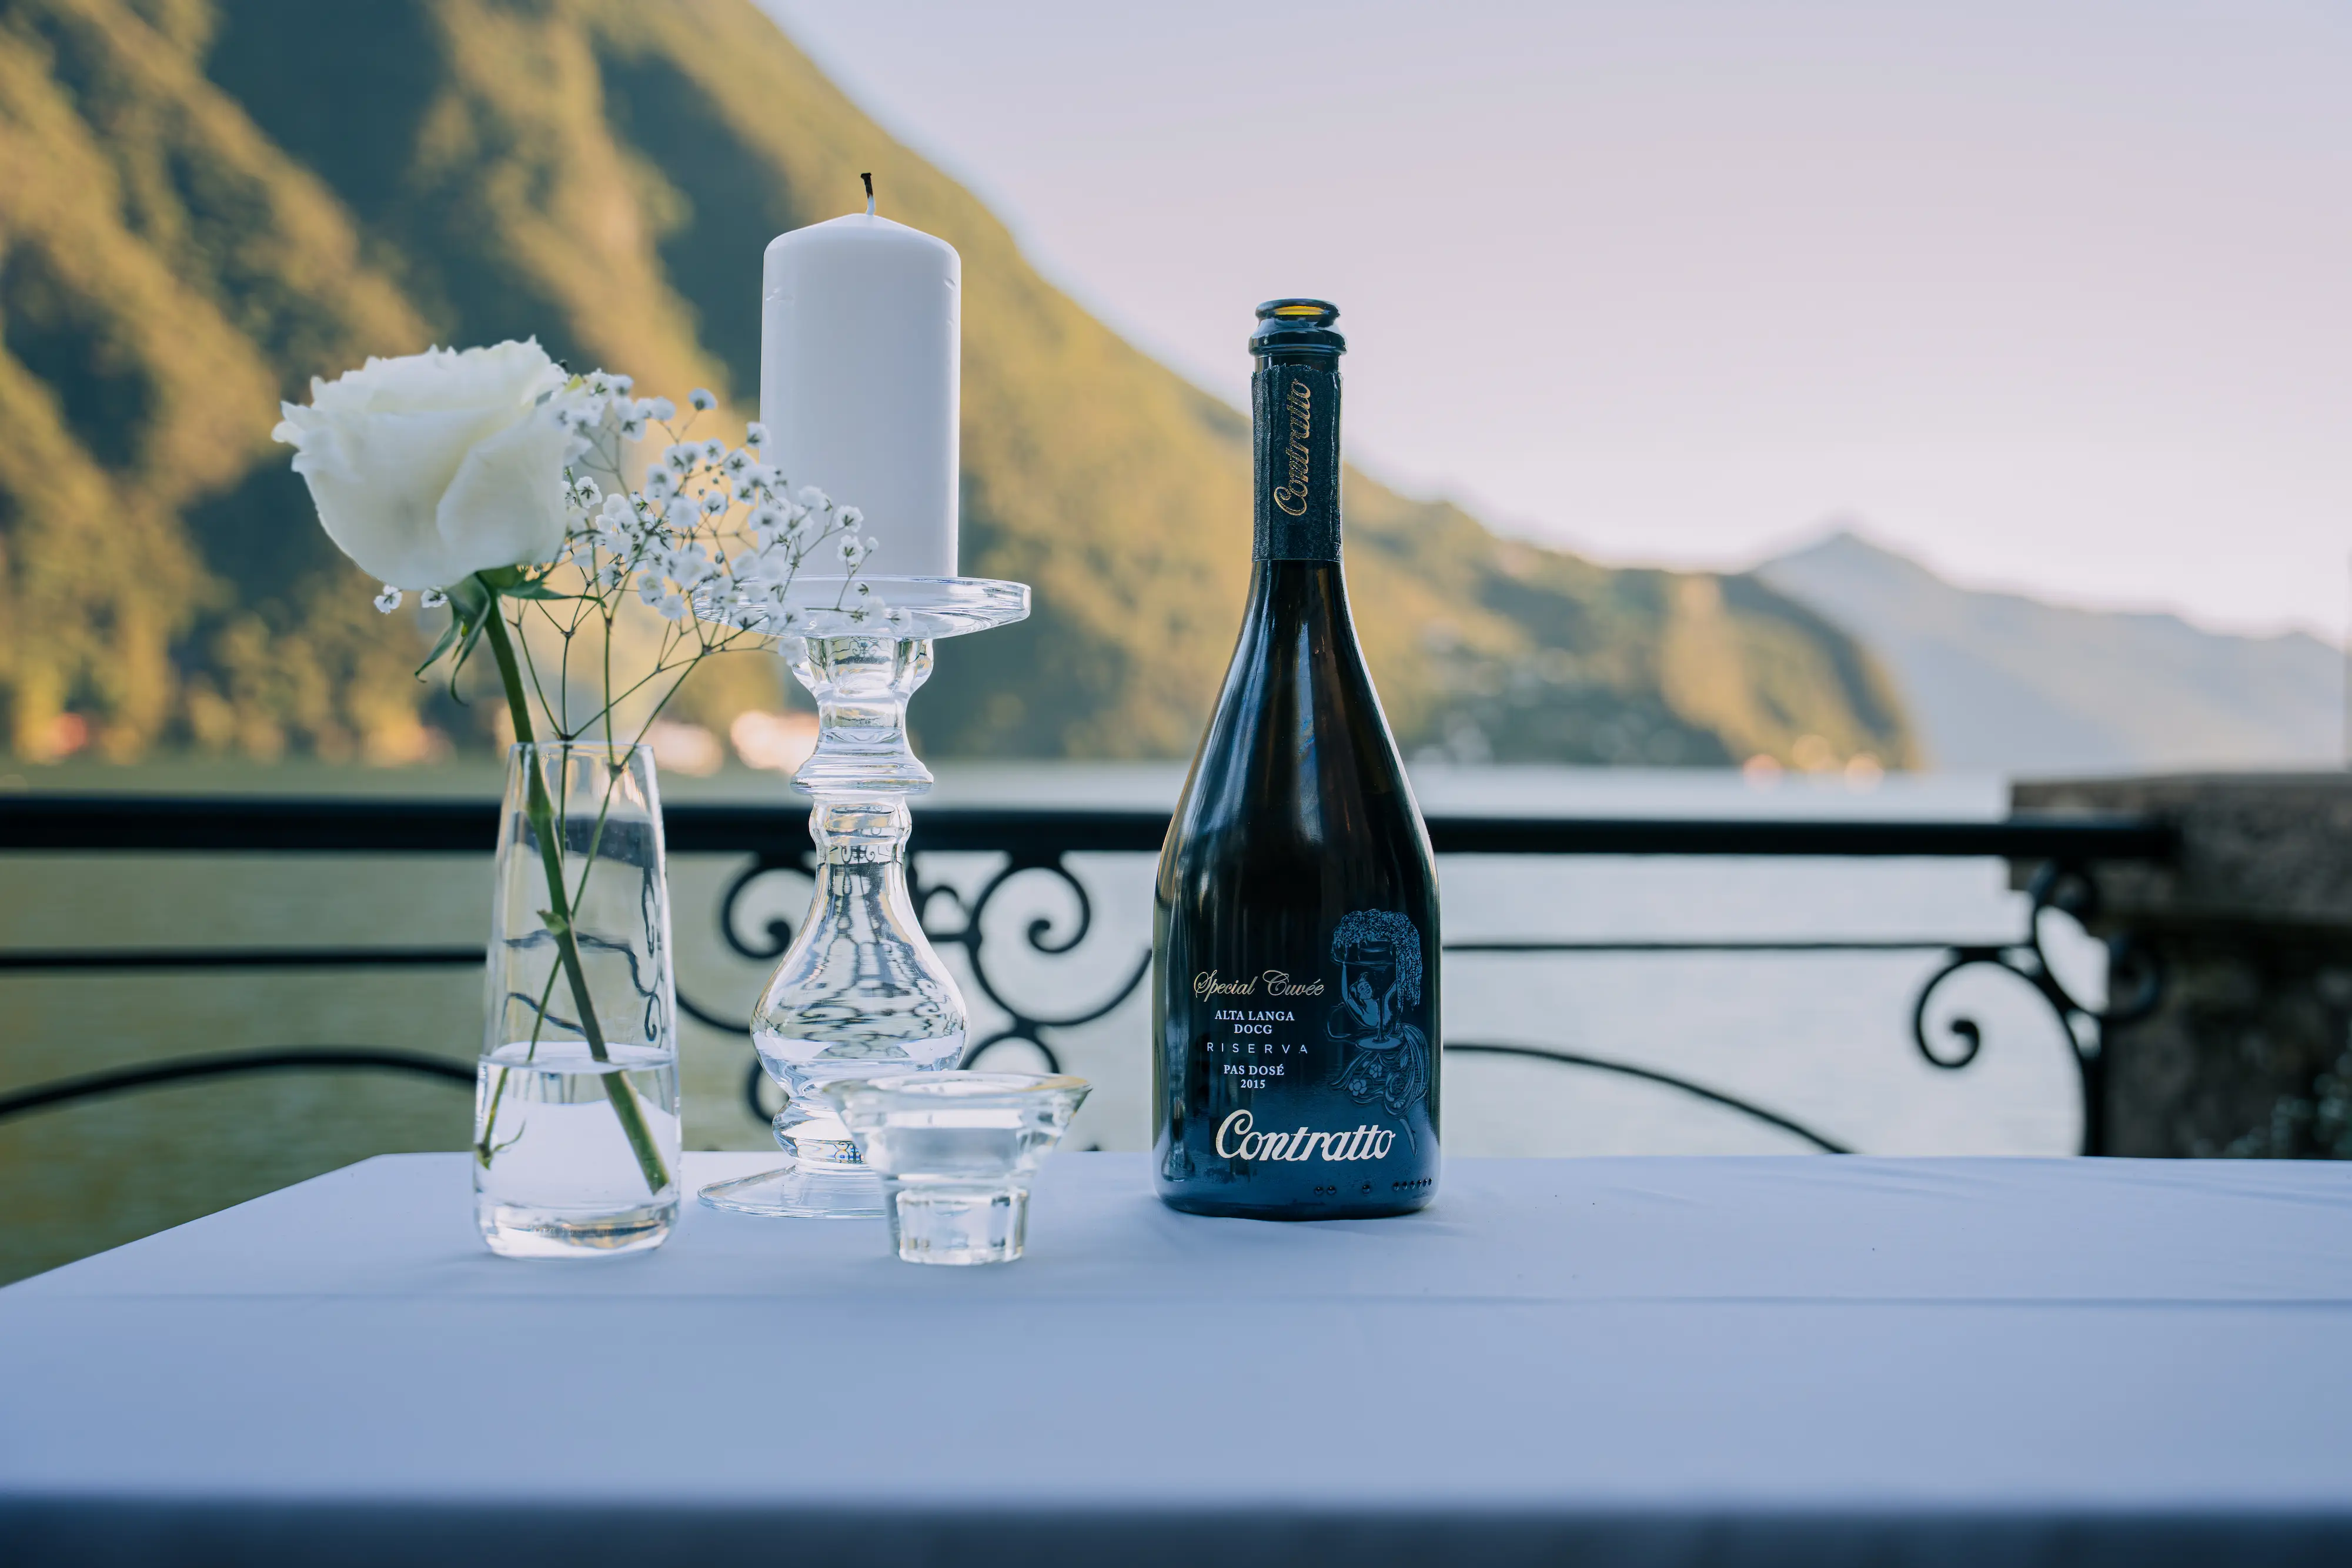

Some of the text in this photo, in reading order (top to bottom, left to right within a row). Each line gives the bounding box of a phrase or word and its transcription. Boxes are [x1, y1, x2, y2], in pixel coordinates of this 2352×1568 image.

[1274, 379, 1311, 516] Contratto
[1194, 970, 1324, 1002] Special Cuvée
[1214, 1010, 1295, 1021] ALTA LANGA
[1234, 1024, 1272, 1035] DOCG
[1207, 1042, 1308, 1054] RISERVA
[1223, 1064, 1284, 1075] PAS DOSÉ
[1240, 1079, 1265, 1089] 2015
[1215, 1109, 1396, 1161] Contratto
